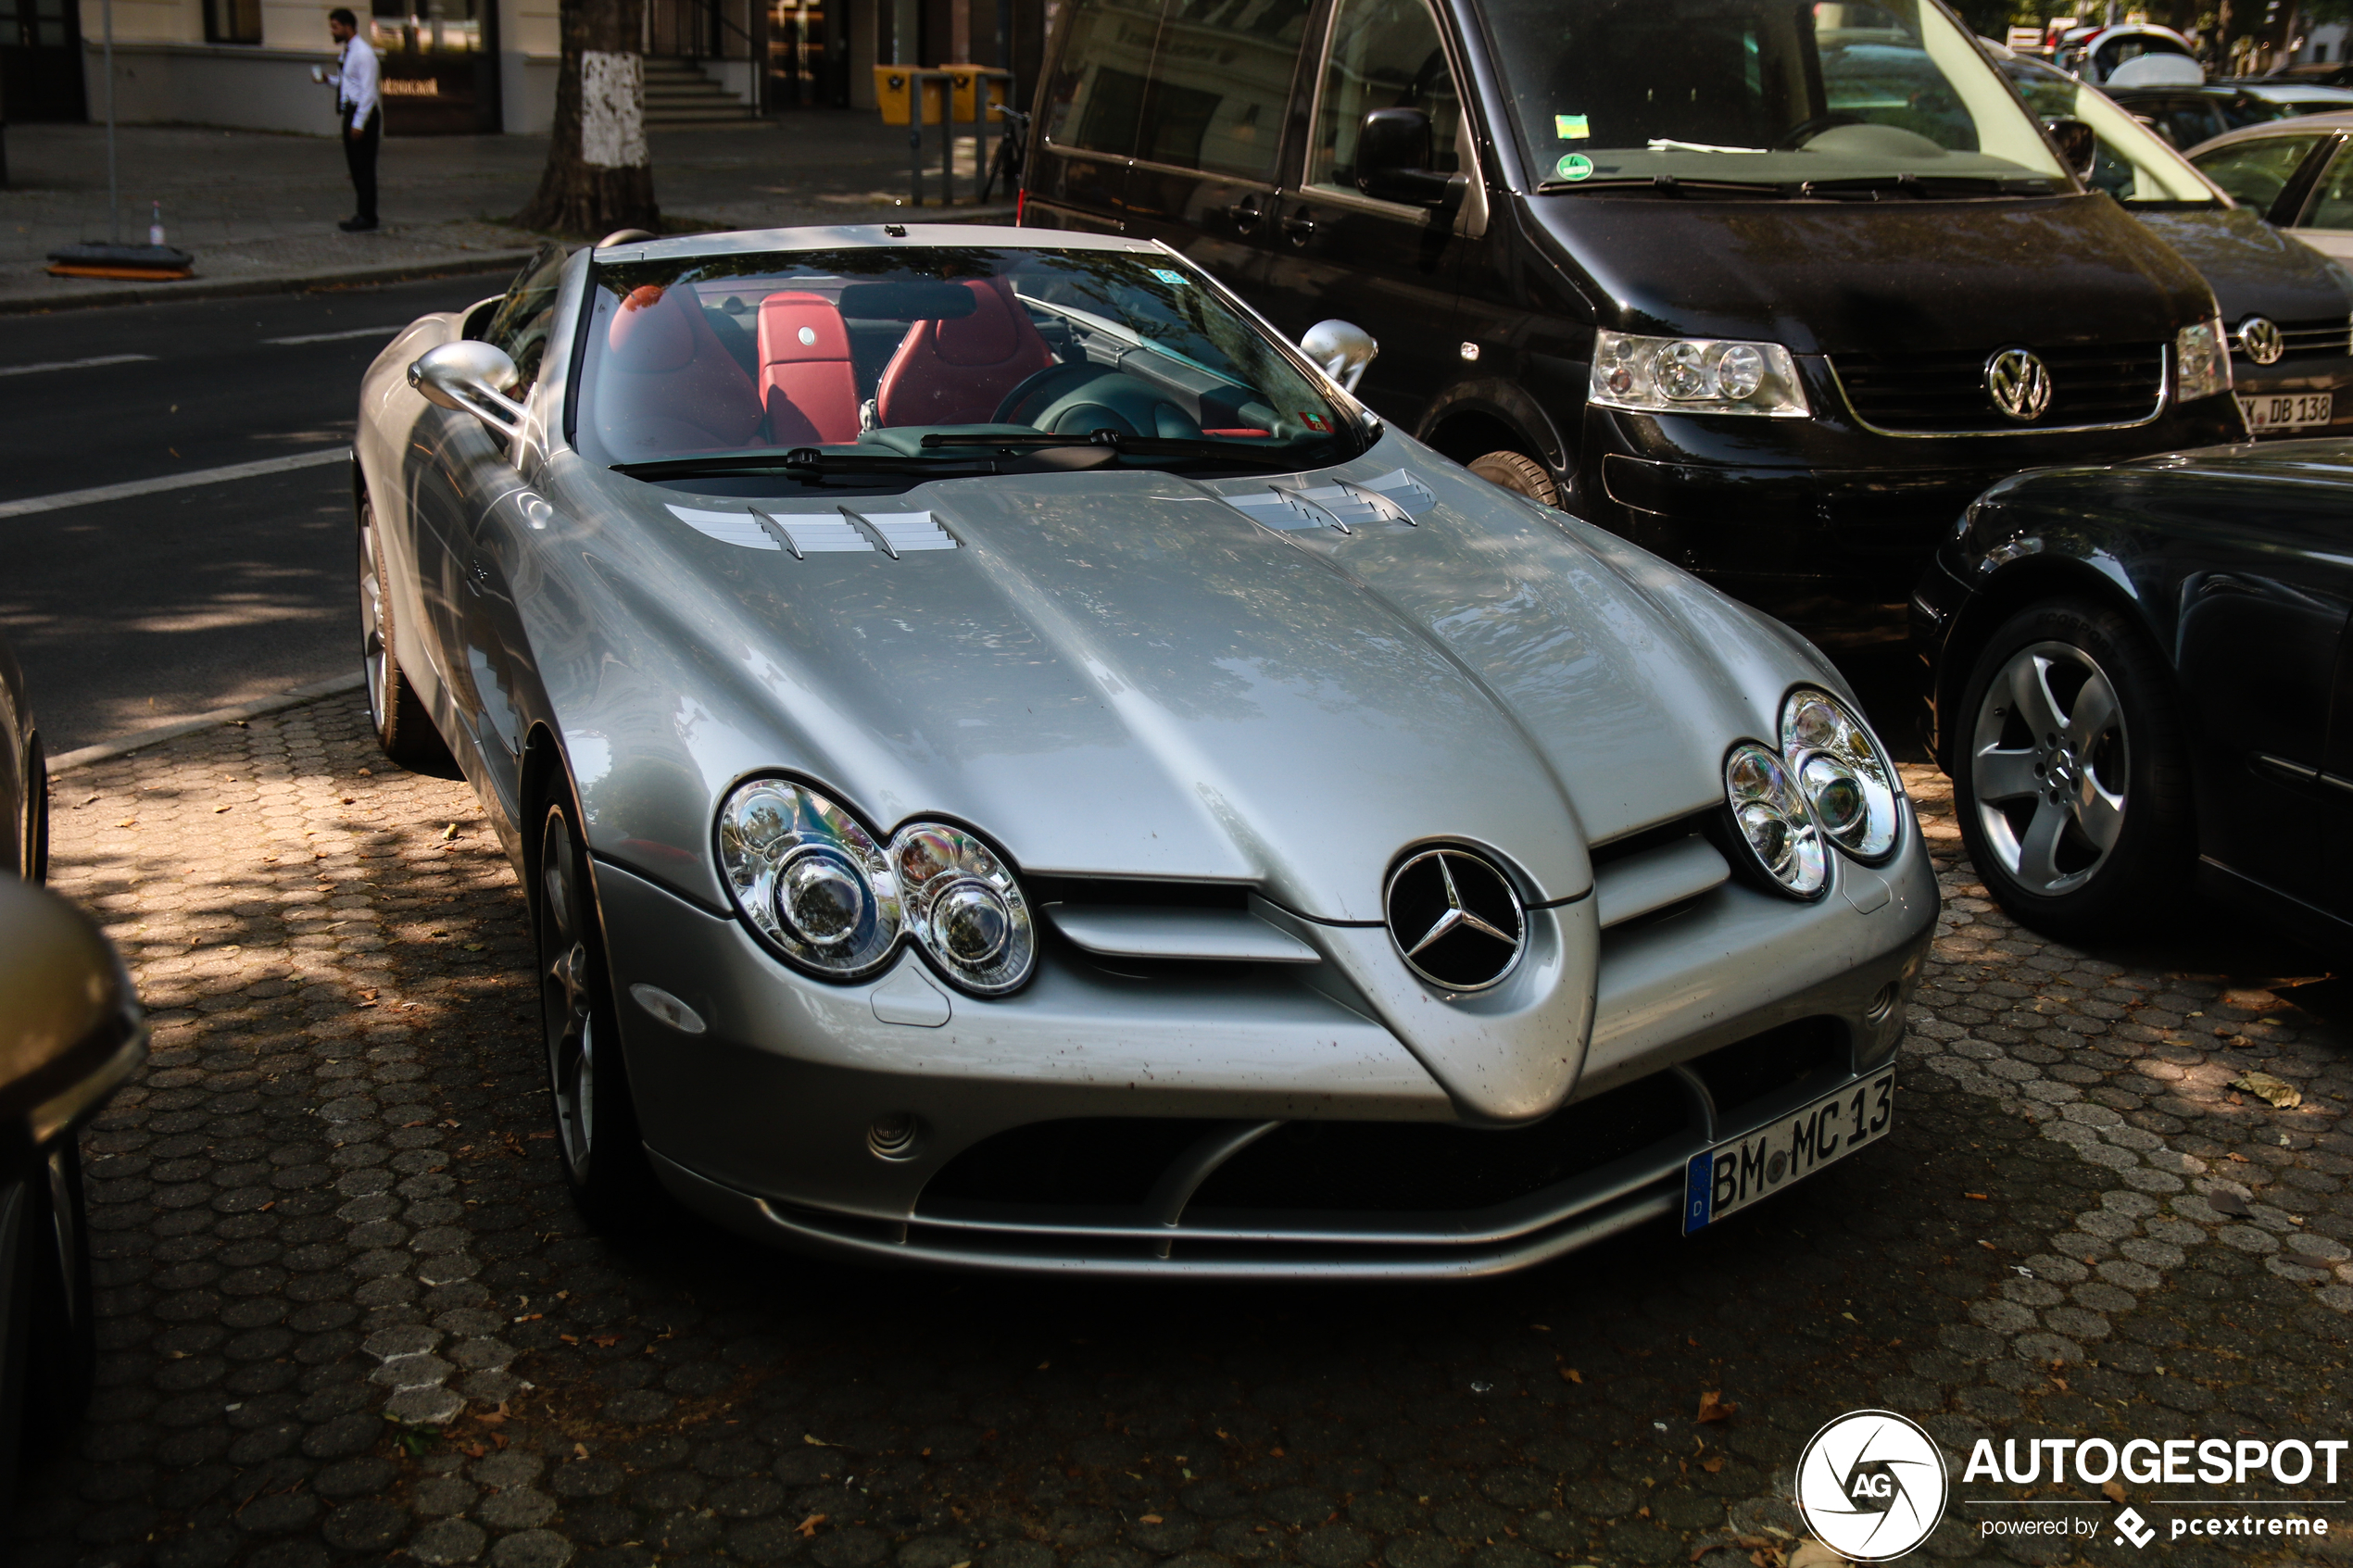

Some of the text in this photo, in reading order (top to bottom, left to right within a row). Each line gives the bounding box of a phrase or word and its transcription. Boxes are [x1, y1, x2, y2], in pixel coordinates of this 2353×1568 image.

[2270, 398, 2294, 422] DB
[2296, 396, 2330, 421] 138
[2036, 612, 2119, 660] ECOSPORT
[1711, 1073, 1893, 1214] BM MC 13
[1692, 1199, 1703, 1217] D
